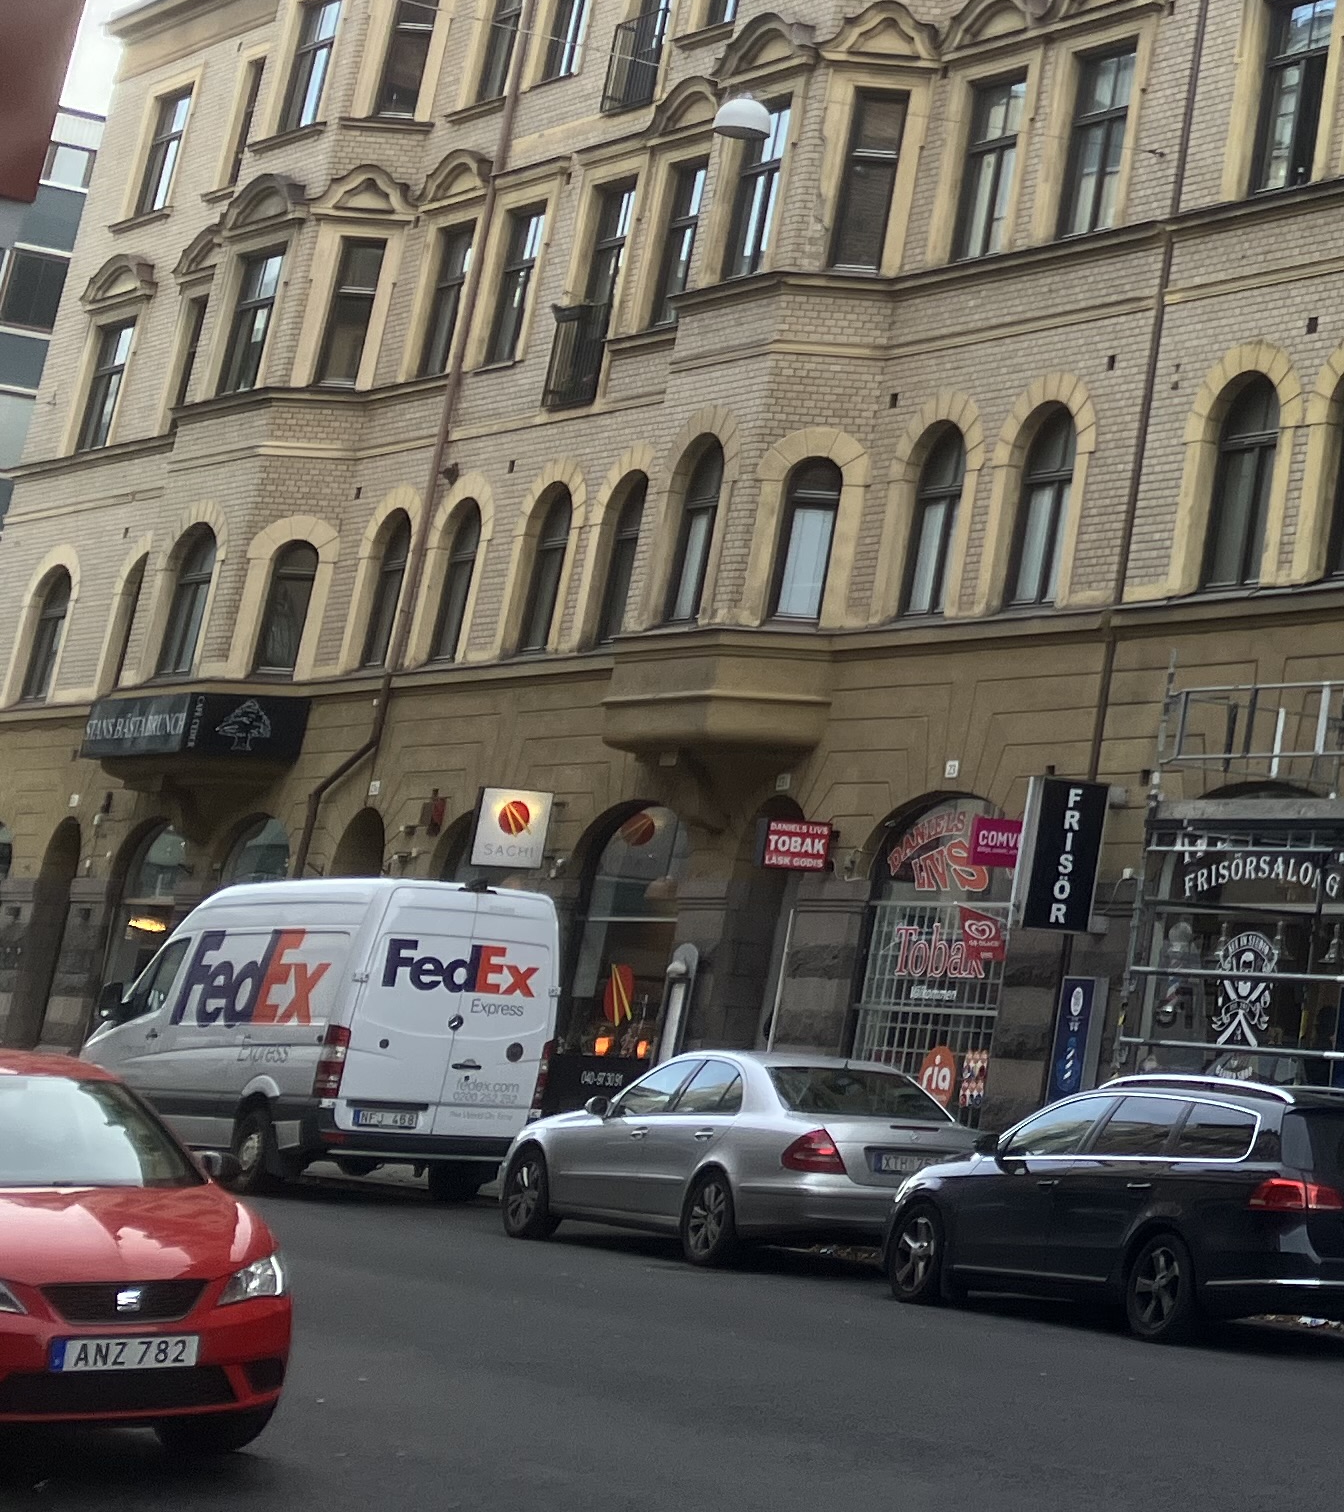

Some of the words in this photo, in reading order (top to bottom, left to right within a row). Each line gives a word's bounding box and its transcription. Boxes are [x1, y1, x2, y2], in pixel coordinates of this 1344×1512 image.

[770, 822, 807, 833] DANIELS
[809, 824, 828, 835] LIVS
[484, 843, 535, 858] SACHI
[768, 835, 825, 855] TOBAK
[887, 811, 967, 876] DANIELS
[793, 857, 823, 868] GODIS
[912, 839, 989, 892] LIVS
[1049, 788, 1083, 924] FRISÖR
[169, 928, 332, 1029] FedEx
[382, 938, 539, 997] FedEx
[471, 998, 524, 1017] Express
[361, 1112, 384, 1125] NFJ
[74, 1343, 128, 1367] ANZ
[137, 1339, 187, 1364] 782
